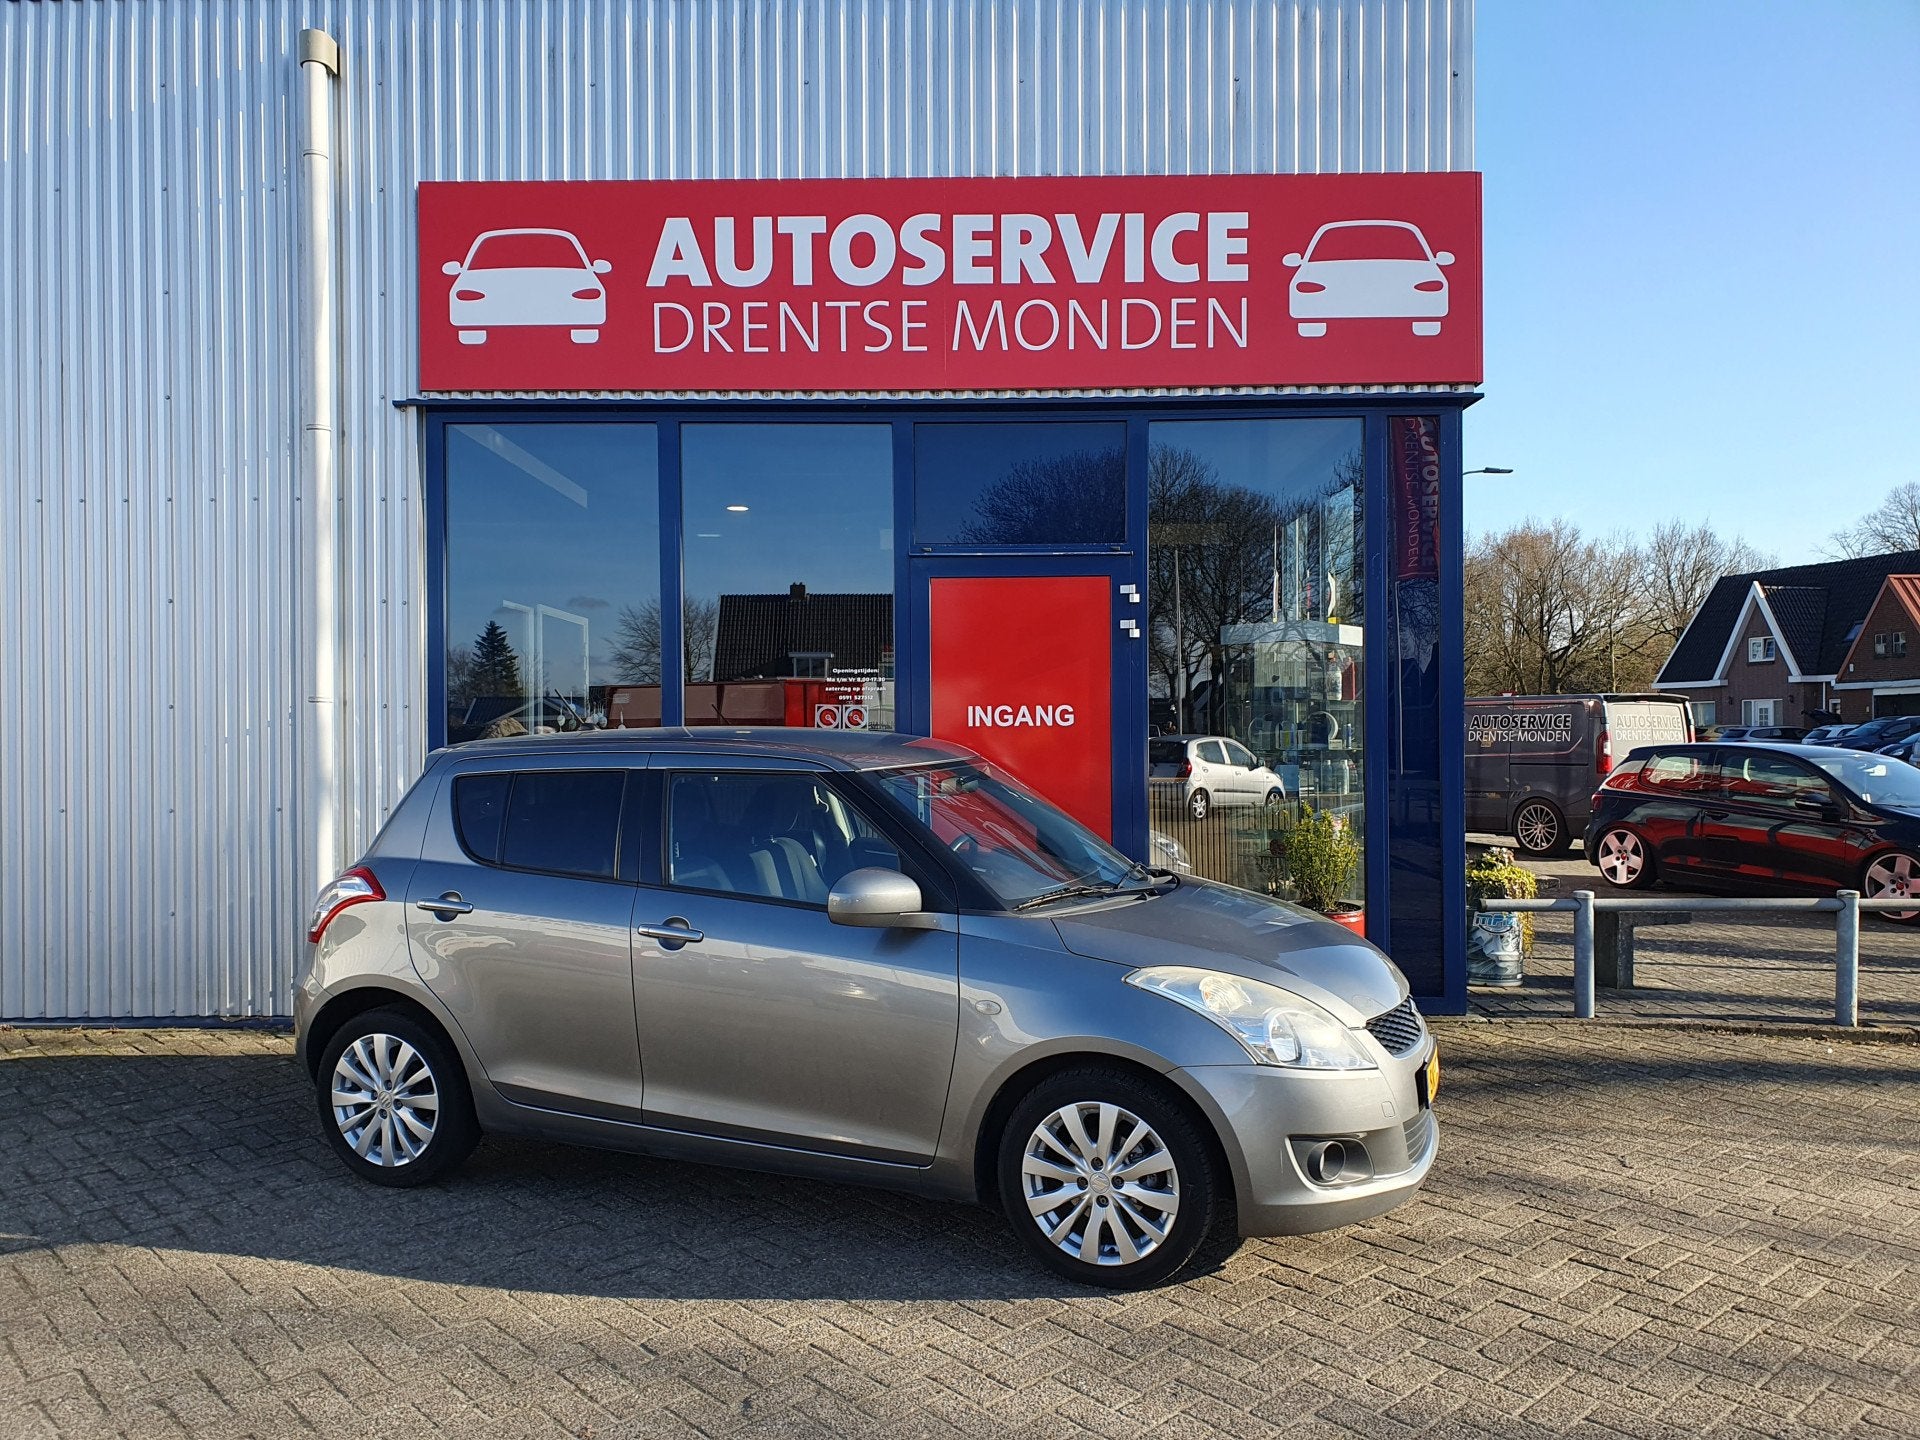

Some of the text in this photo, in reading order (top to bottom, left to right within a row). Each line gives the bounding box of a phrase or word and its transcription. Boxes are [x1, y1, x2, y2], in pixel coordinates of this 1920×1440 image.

[646, 211, 1250, 288] AUTOSERVICE
[654, 297, 1249, 354] DRENTSE MONDEN
[1406, 495, 1420, 568] MONDEN
[967, 704, 1076, 727] INGANG
[1469, 714, 1572, 730] AUTOSERVICE
[1616, 714, 1682, 729] AUTOSERVICE
[1468, 730, 1571, 742] DRENTSE MONDEN
[1615, 730, 1683, 741] DRENTSE MONDEN
